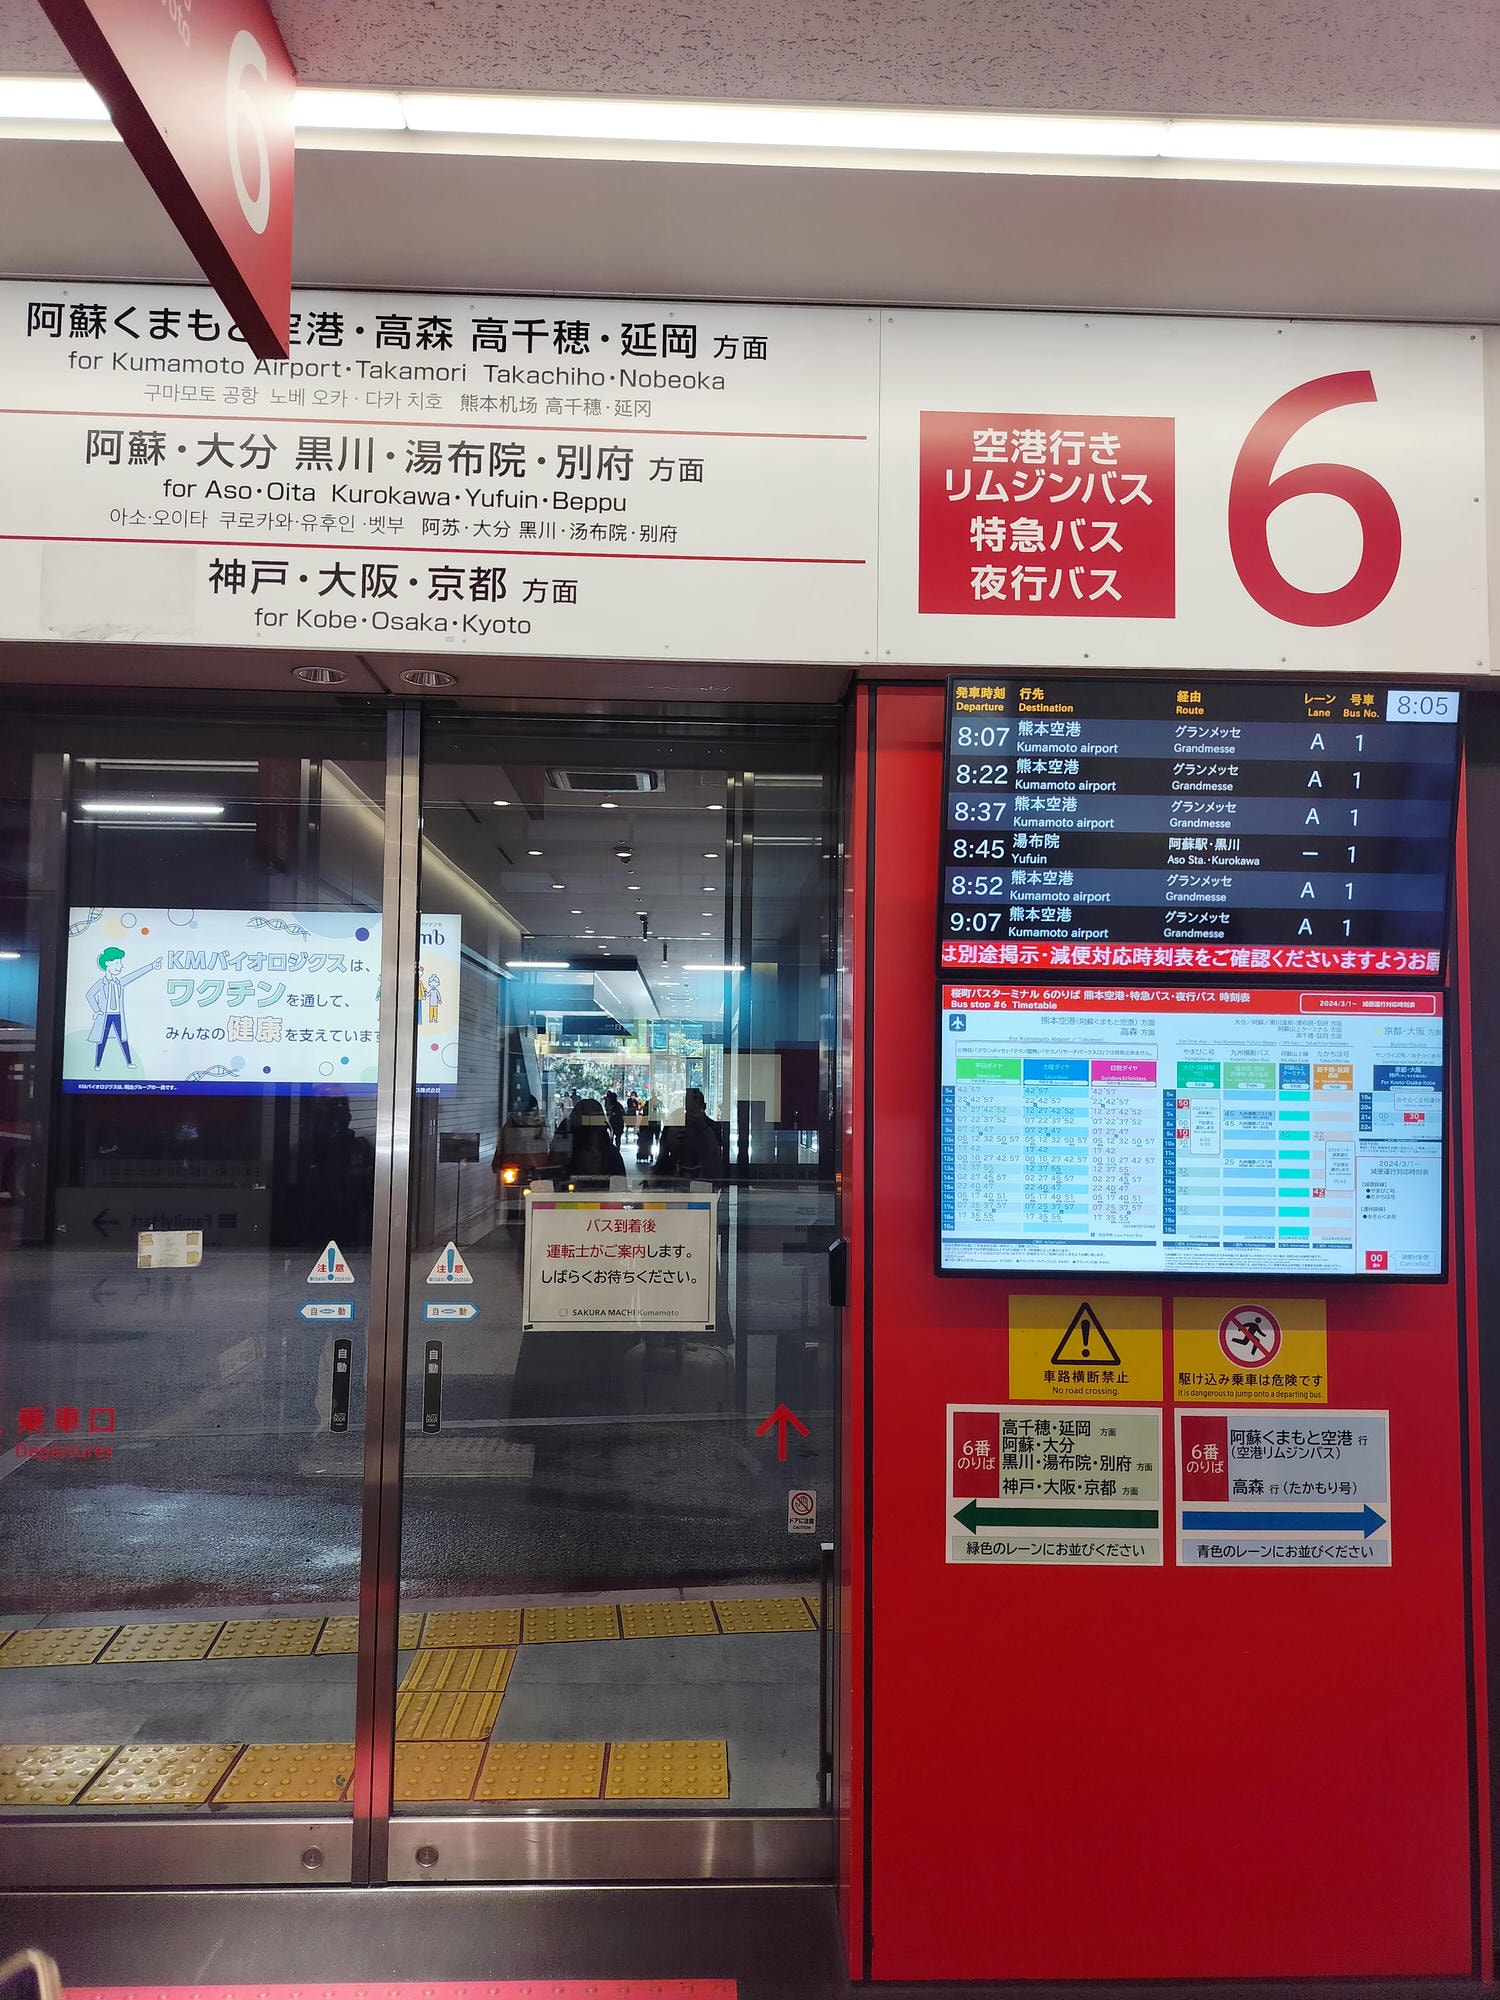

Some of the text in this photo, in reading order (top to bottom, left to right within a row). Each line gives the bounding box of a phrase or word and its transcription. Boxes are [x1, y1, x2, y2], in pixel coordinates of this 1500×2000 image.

[226, 29, 270, 234] 6
[471, 317, 697, 359] 高千穂・延岡
[713, 334, 768, 360] 方面
[69, 351, 103, 370] for
[113, 353, 244, 374] Kumamoto
[144, 385, 216, 402] 구마모토
[223, 386, 258, 405] 공항
[271, 388, 305, 406] 노베
[312, 389, 348, 408] 오카
[460, 395, 538, 414] 熊本机场
[86, 429, 704, 482] 阿蘇・大分 黒川・湯布院・別府 方面
[972, 428, 1121, 466] 空港行き
[164, 480, 197, 498] for
[944, 469, 1153, 505] リムジンバス
[1228, 370, 1402, 627] 6
[970, 516, 1123, 554] 特急バス
[208, 558, 578, 604] 神戸・大阪・京都 方面
[970, 565, 1122, 602] 夜行バス
[254, 608, 288, 626] for
[956, 687, 1375, 706] 発車時刻 行先 経由 レーン 号車
[956, 702, 1379, 718] Departure Destination Route Lane Bus No.
[1397, 696, 1449, 715] 8:05
[958, 721, 1363, 751] 8:07 熊本空港 グランメッセ A 1
[1017, 742, 1235, 755] Kumamoto airport Grandmesse
[956, 759, 1361, 789] 8:22 熊本空港 グランメッセ A 1
[1015, 779, 1233, 793] Kumamoto airport Grandmesse
[953, 834, 1356, 863] 8:45 湯布院 阿蘇駅・黒川 1
[1011, 854, 1047, 864] Yufuin
[1167, 856, 1185, 864] Aso
[950, 907, 1350, 936] 9:07 熊本空港 グランメッセ A 1
[1008, 927, 1224, 940] Kumamoto airport Grandmesse
[167, 978, 350, 1009] ワクチンを通して、
[951, 989, 1039, 999] 桜町バスターミナル
[1043, 991, 1080, 999] 6のりば
[1219, 993, 1250, 1002] 時刻表
[994, 1001, 1006, 1009] #6
[1013, 1002, 1057, 1010] Timetable
[587, 1219, 656, 1233] バス到着後
[547, 1244, 692, 1259] 運転士がご案内します。
[542, 1269, 697, 1284] しばらくお待ちください。
[638, 1309, 679, 1317] Kumamoto
[337, 1348, 347, 1373] 自動
[429, 1349, 438, 1374] 自動
[1043, 1370, 1128, 1384] 車路横断禁止
[1178, 1372, 1323, 1387] 駆け込み乗車は危険です
[1085, 1388, 1119, 1396] crossing.
[1191, 1390, 1226, 1398] dangerous
[1235, 1390, 1252, 1399] jump
[1276, 1391, 1307, 1399] departing
[17, 1406, 115, 1433] 乗車口
[1002, 1419, 1116, 1436] 高千穂・延岡 方面
[1002, 1437, 1075, 1454] 阿蘇・大分
[1231, 1430, 1367, 1446] 阿蘇くまもと空港 行
[15, 1443, 113, 1460] Departures
[963, 1440, 990, 1457] 6番
[1191, 1444, 1219, 1461] 6番
[957, 1457, 995, 1470] のりば
[1002, 1454, 1152, 1472] 黒川・湯布院・別府 方面
[1187, 1460, 1224, 1474] のりば
[1002, 1479, 1138, 1496] 神戸・大阪・京都 方面
[1232, 1478, 1264, 1495] 高森
[1270, 1485, 1279, 1493] 行
[967, 1541, 1144, 1557] 緑色のレーンにお並びください
[1197, 1545, 1373, 1559] 青色のレーンにお並びください
